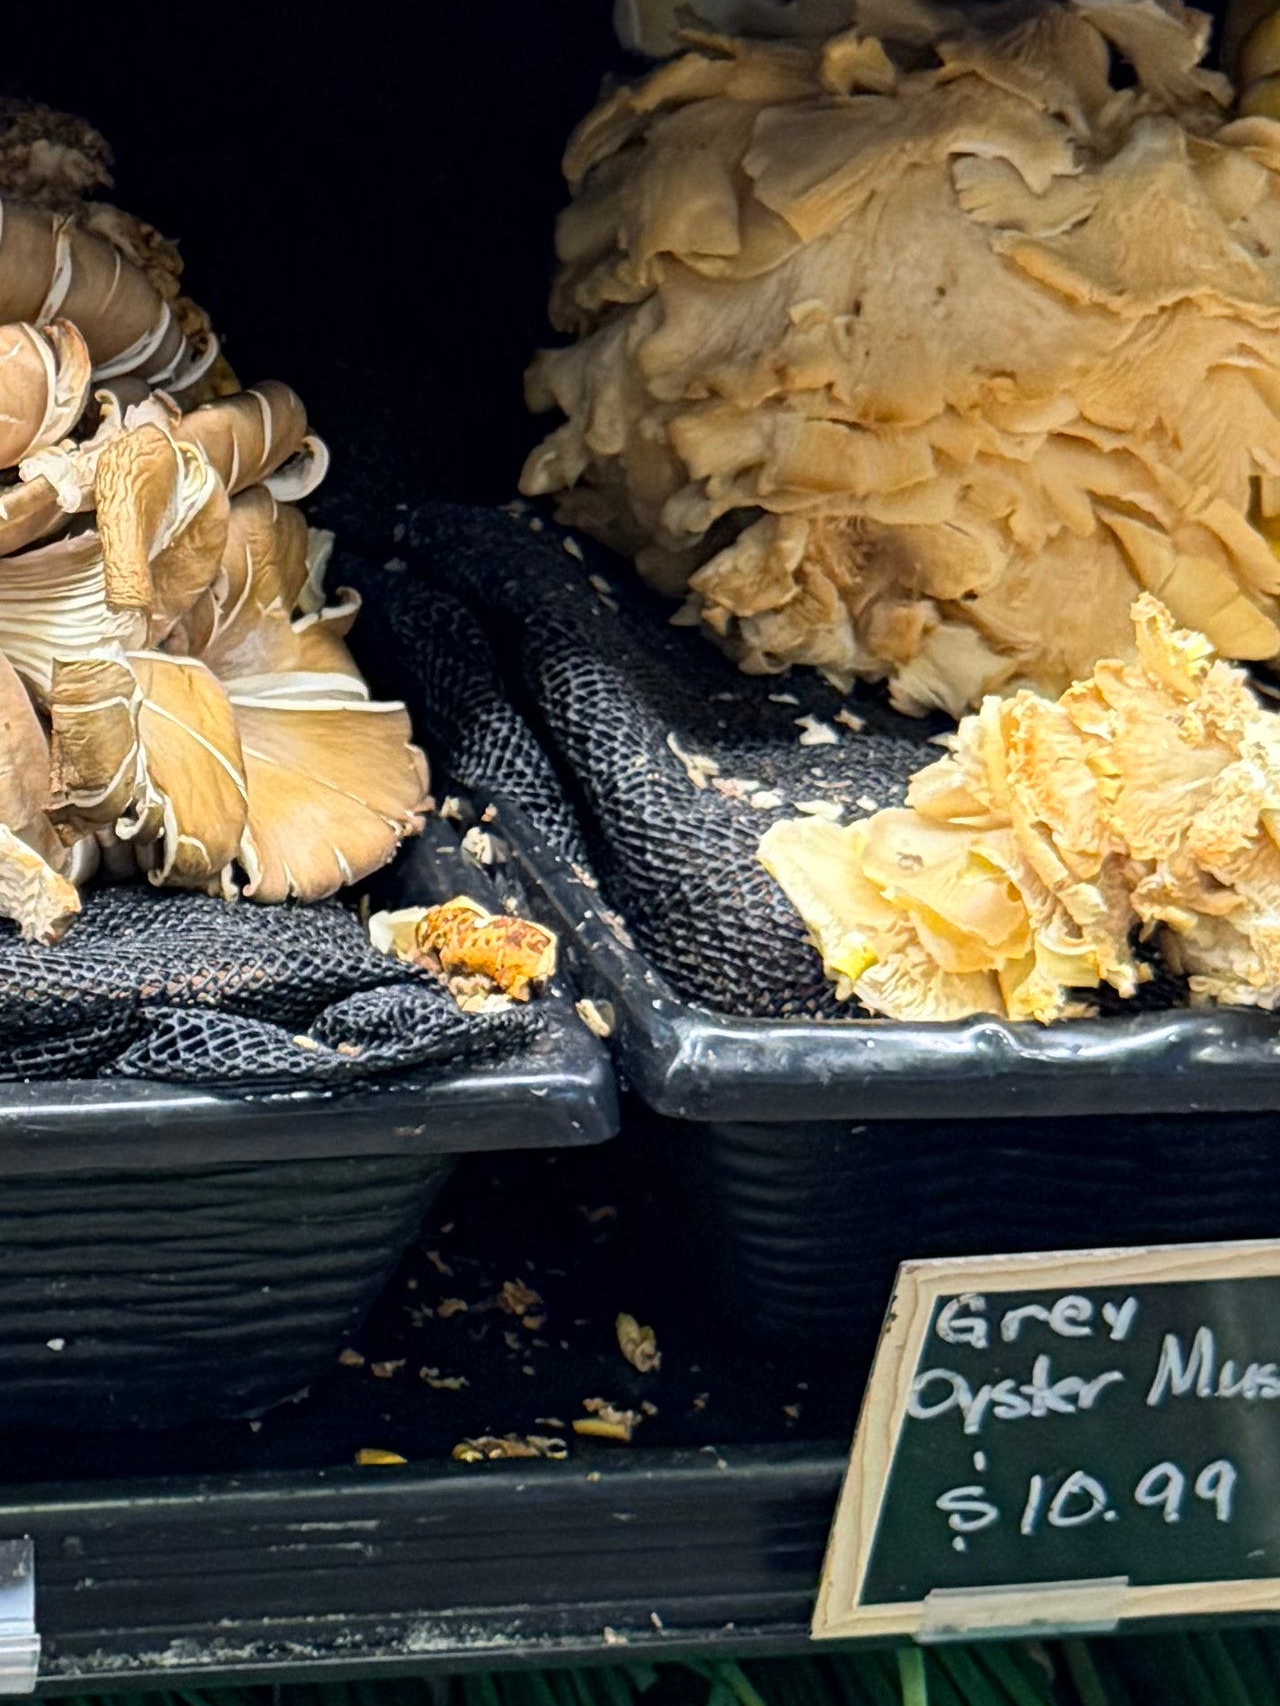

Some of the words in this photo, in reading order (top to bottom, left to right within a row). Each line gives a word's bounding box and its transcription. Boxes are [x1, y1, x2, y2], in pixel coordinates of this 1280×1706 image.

[935, 1294, 1138, 1350] Grey
[907, 1354, 1125, 1435] Oyster
[935, 1450, 1237, 1552] $10.99
